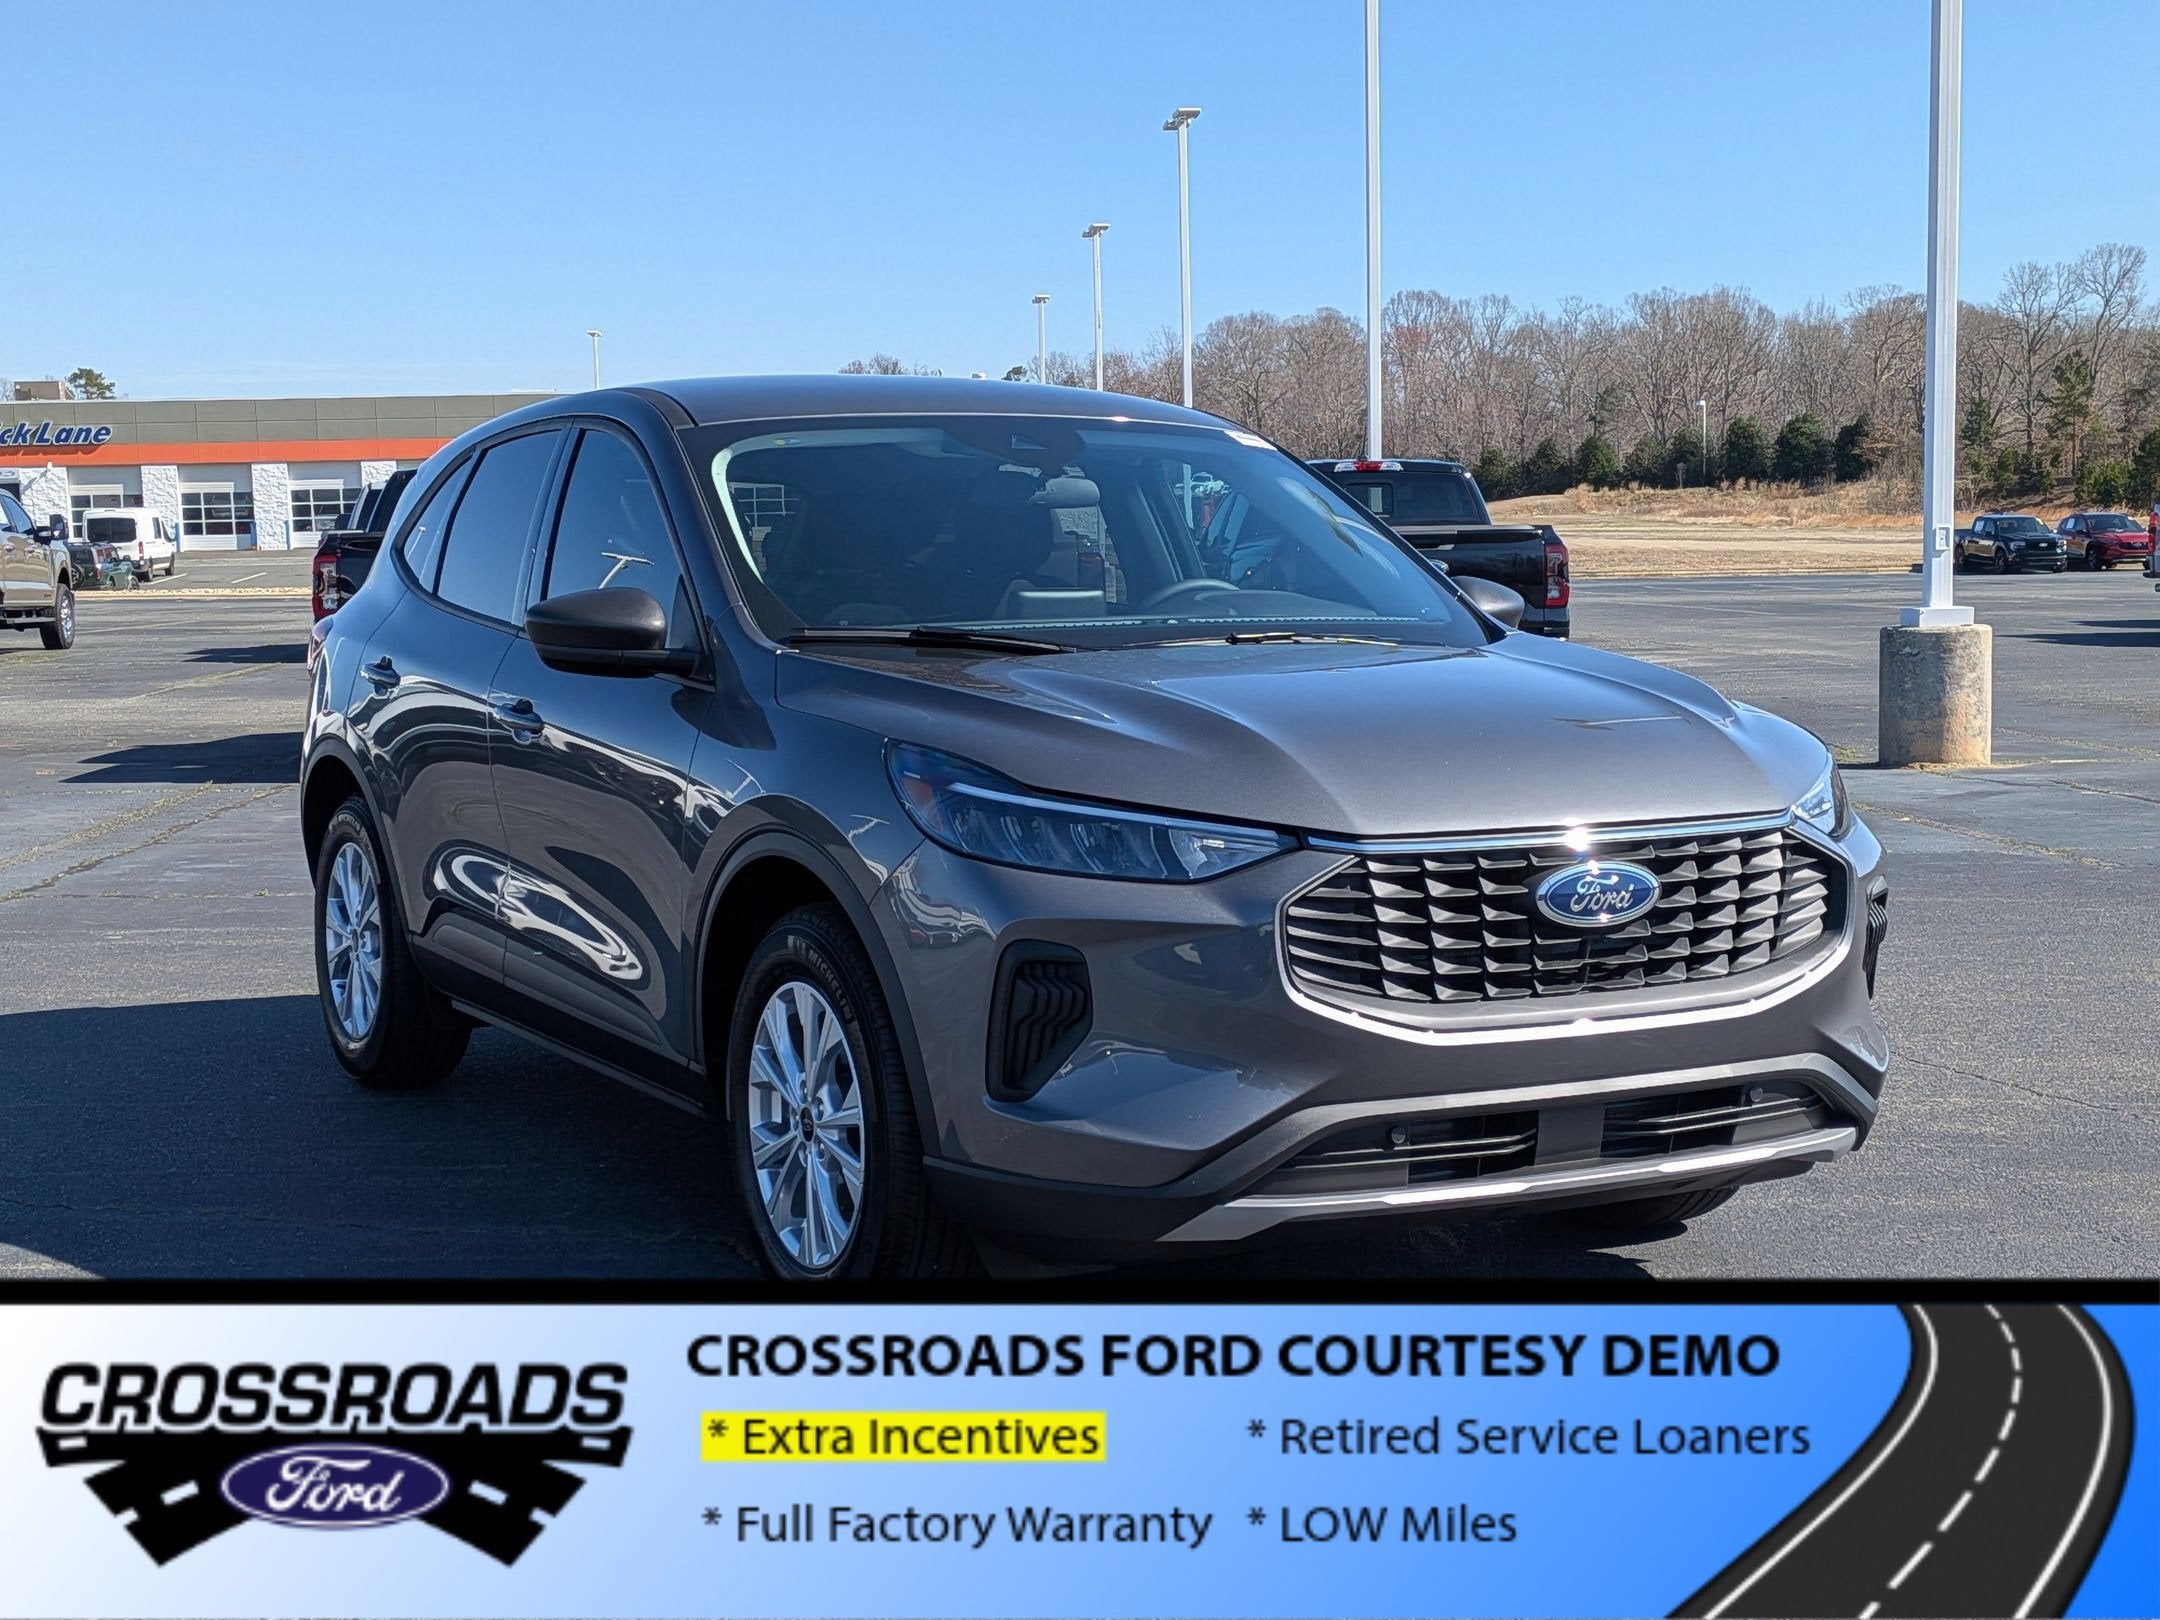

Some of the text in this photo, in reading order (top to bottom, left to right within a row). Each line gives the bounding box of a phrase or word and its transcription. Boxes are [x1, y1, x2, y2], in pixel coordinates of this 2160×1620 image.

[0, 419, 112, 446] ck Lane
[1570, 874, 1636, 913] Ford
